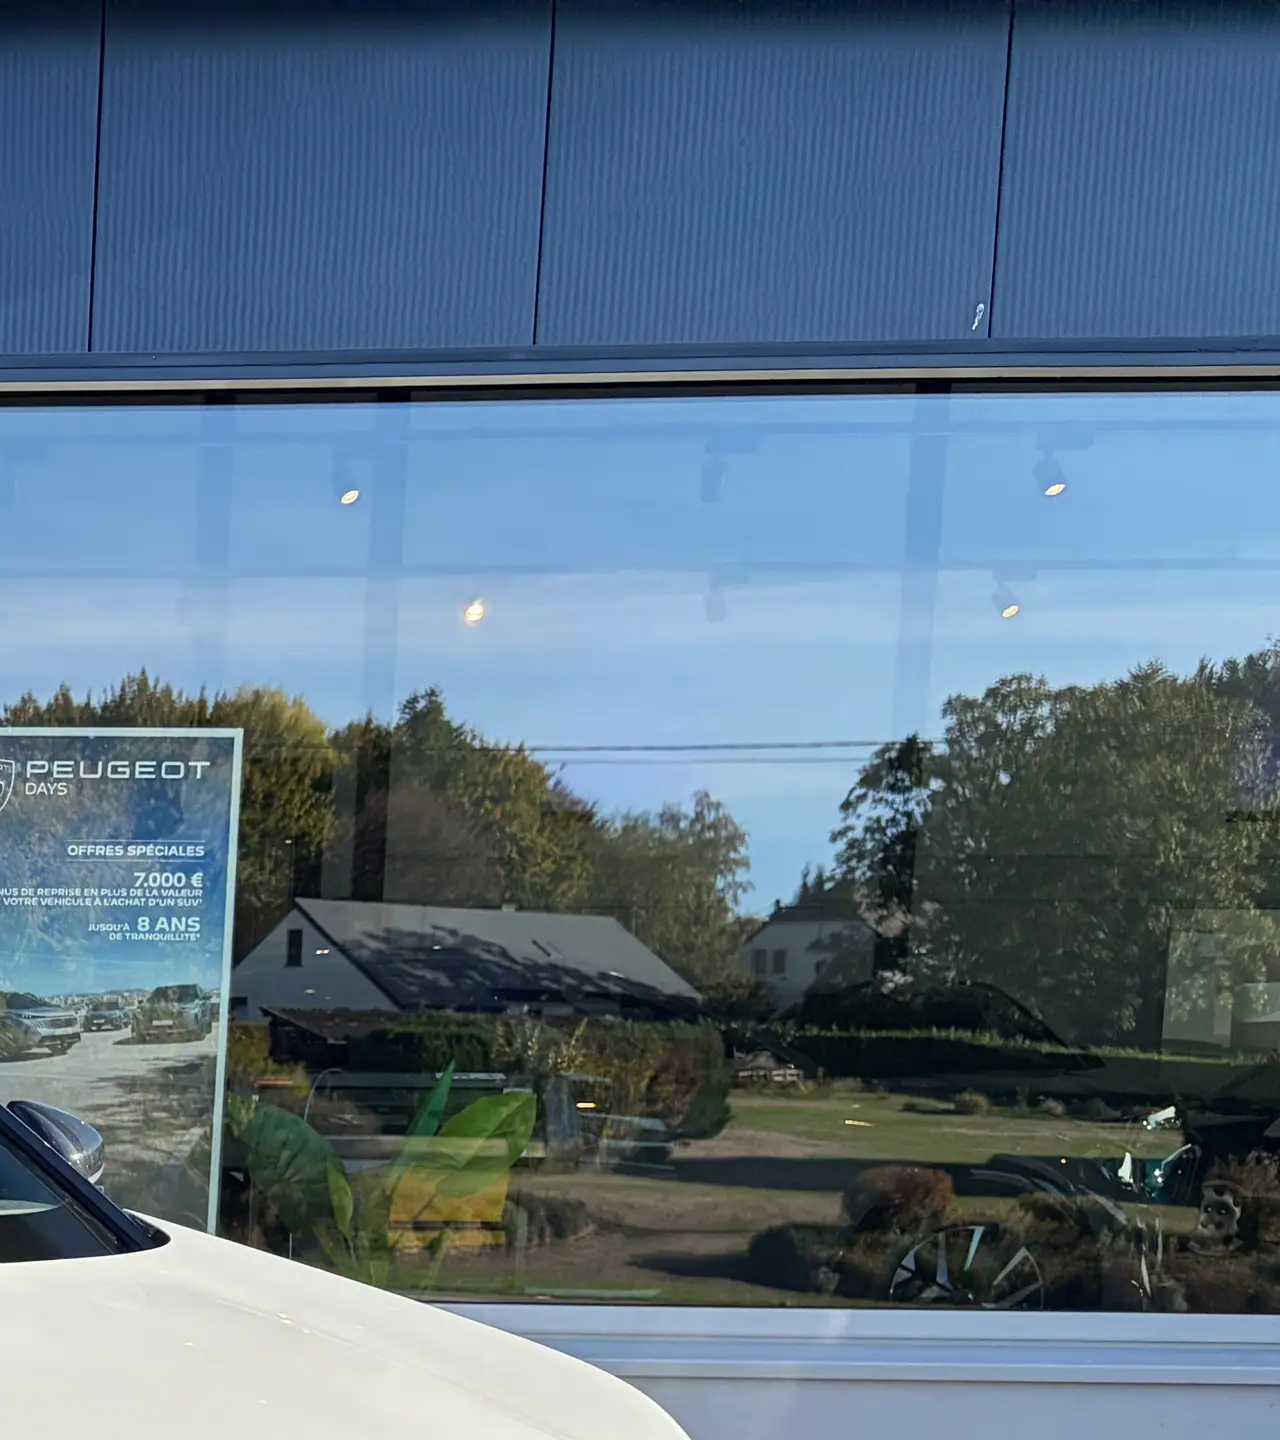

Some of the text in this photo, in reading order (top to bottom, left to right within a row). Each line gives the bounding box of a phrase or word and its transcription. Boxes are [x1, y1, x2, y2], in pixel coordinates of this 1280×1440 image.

[26, 761, 211, 779] PEUGEOT
[25, 782, 68, 795] DAYS
[67, 843, 205, 857] OFFRES SPÉCIALES
[133, 872, 203, 888] 7.000 €
[21, 887, 35, 896] DE
[36, 887, 82, 896] REPRISE
[83, 888, 98, 896] EN
[100, 888, 127, 896] PLUS
[129, 888, 144, 896] DE
[145, 888, 159, 897] LA
[161, 888, 203, 897] VALEUR
[3, 897, 38, 906] VOTRE
[103, 898, 146, 906] L'ACHAT
[148, 898, 174, 906] D'UN
[137, 916, 150, 931] 8
[154, 916, 200, 932] ANS
[109, 933, 122, 941] DE
